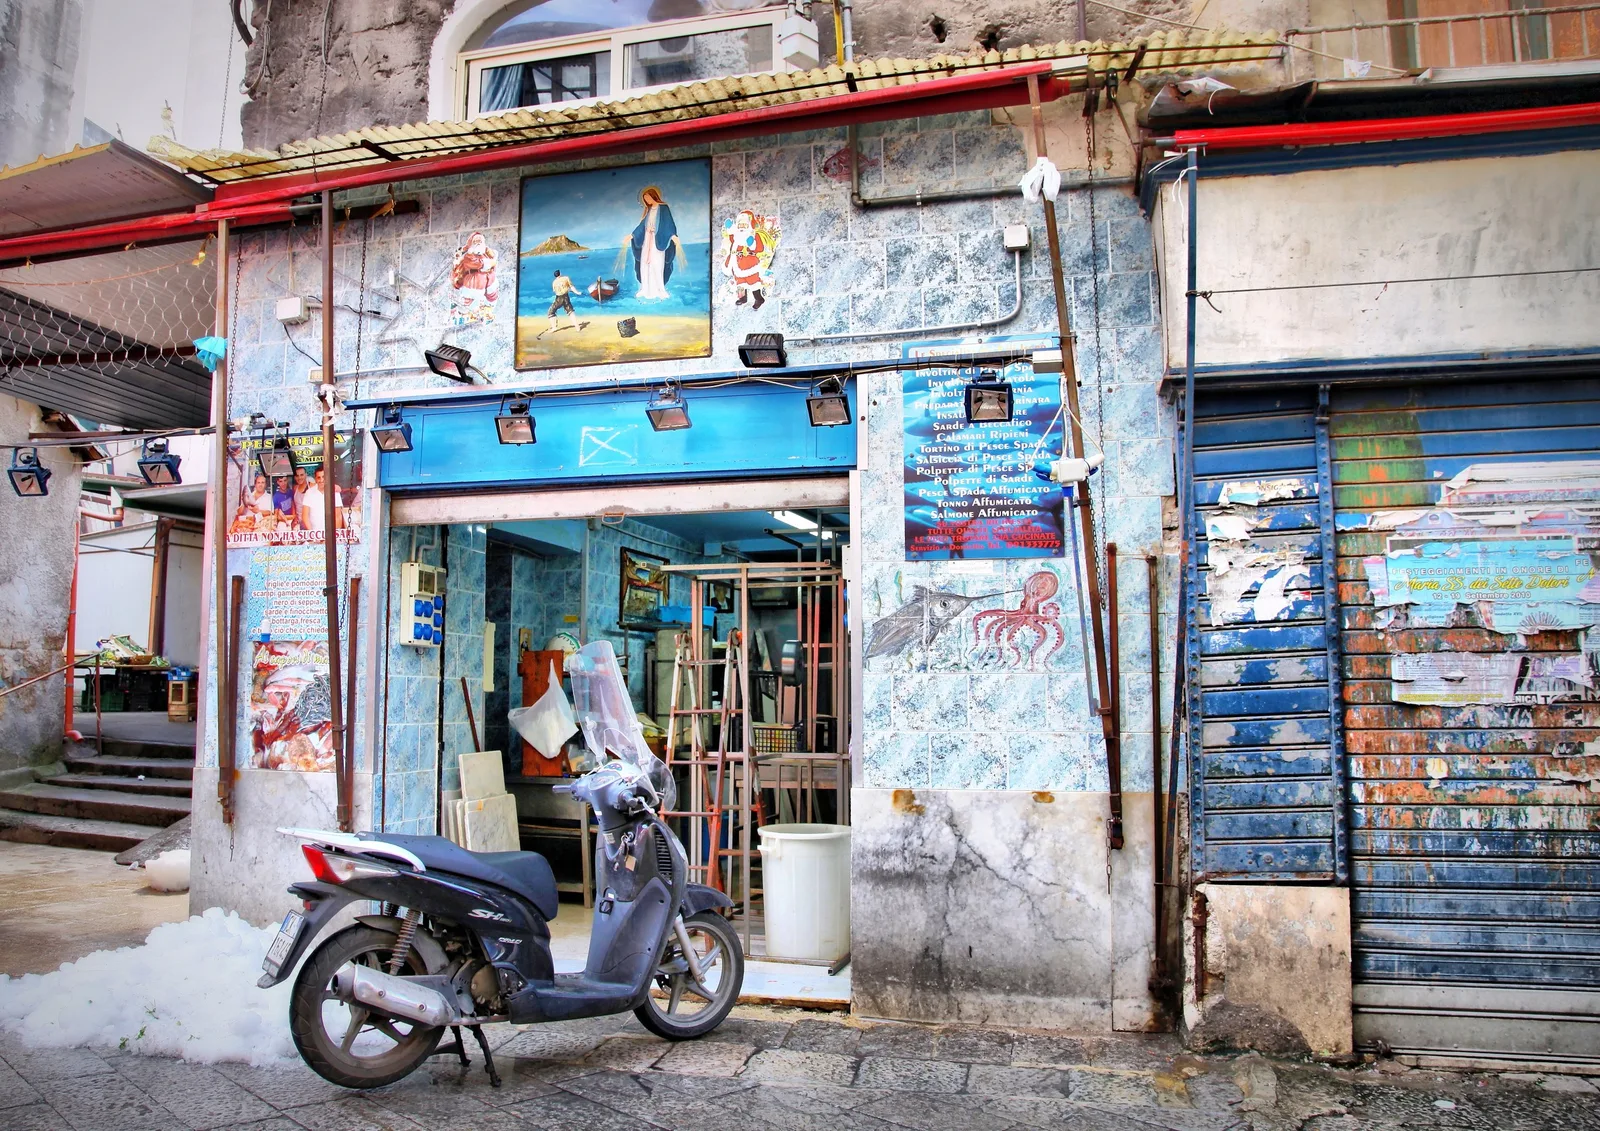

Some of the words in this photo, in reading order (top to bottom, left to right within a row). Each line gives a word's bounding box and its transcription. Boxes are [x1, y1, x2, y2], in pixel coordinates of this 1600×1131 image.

[931, 388, 966, 398] Involti
[937, 409, 966, 420] Insala
[935, 431, 986, 442] Calamari
[990, 429, 1029, 440] Ripieni
[241, 434, 346, 449] PESHERA
[919, 444, 960, 454] Tortino
[964, 442, 975, 451] di
[979, 442, 1009, 451] Pesce
[1013, 439, 1048, 451] Spada
[916, 455, 963, 465] Salsiccia
[968, 453, 978, 462] di
[982, 452, 1013, 462] Pesce
[1018, 450, 1052, 463] Spada
[916, 466, 964, 477] Polpette
[968, 464, 978, 473] di
[982, 464, 1013, 474] Pesce
[934, 475, 982, 487] Polpette
[986, 474, 996, 484] di
[1001, 473, 1034, 482] Sarde
[918, 488, 948, 498] Pesce
[953, 486, 986, 498] Spada
[990, 484, 1050, 494] Affumicato
[936, 499, 968, 508] Tonno
[972, 496, 1032, 507] Affumicato
[930, 510, 974, 519] Salmone
[978, 508, 1038, 517] Affumicato
[234, 533, 258, 542] DITTA
[262, 532, 280, 540] NON
[283, 532, 295, 540] HA
[298, 529, 355, 540] SUCCUSALI
[956, 526, 988, 534] QUESTE
[1392, 567, 1491, 576] FESTEGGIAMENTI
[1512, 566, 1552, 574] ONORE
[291, 580, 326, 589] pomodorin
[1394, 576, 1440, 592] Maria
[1470, 577, 1489, 590] dei
[1489, 574, 1523, 591] Sette
[1525, 574, 1570, 589] Dolori
[252, 590, 276, 598] scampi
[278, 588, 314, 598] gamberetto
[1465, 592, 1509, 600] Settembre
[298, 599, 320, 608] seppia
[272, 618, 298, 626] bottarga
[1515, 694, 1537, 704] NICA
